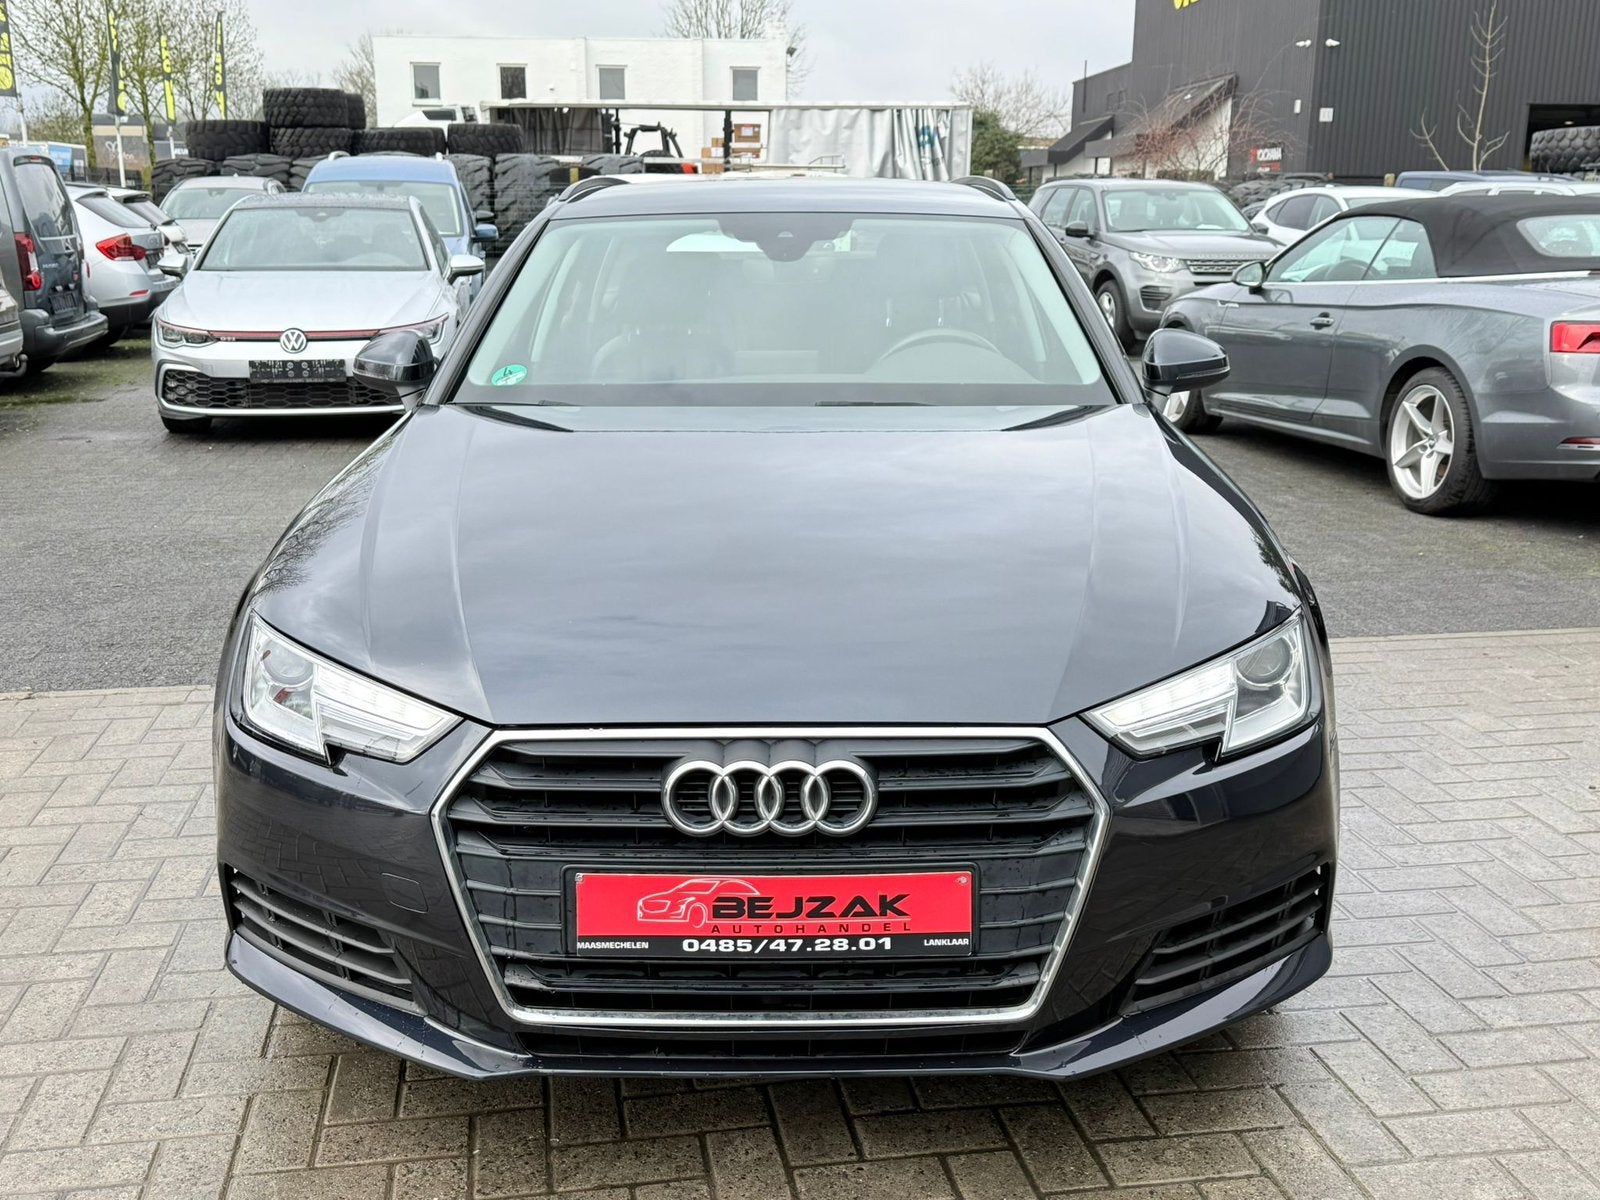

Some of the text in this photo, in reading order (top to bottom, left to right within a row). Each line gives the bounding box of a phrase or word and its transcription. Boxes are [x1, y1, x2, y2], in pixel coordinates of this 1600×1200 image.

[711, 893, 912, 919] BEJZAK
[711, 922, 912, 934] AUTOHANDEL
[576, 941, 649, 950] MAASMECHELEN
[681, 937, 893, 954] 0485/47.28.01
[923, 937, 970, 947] LANKLAAR
